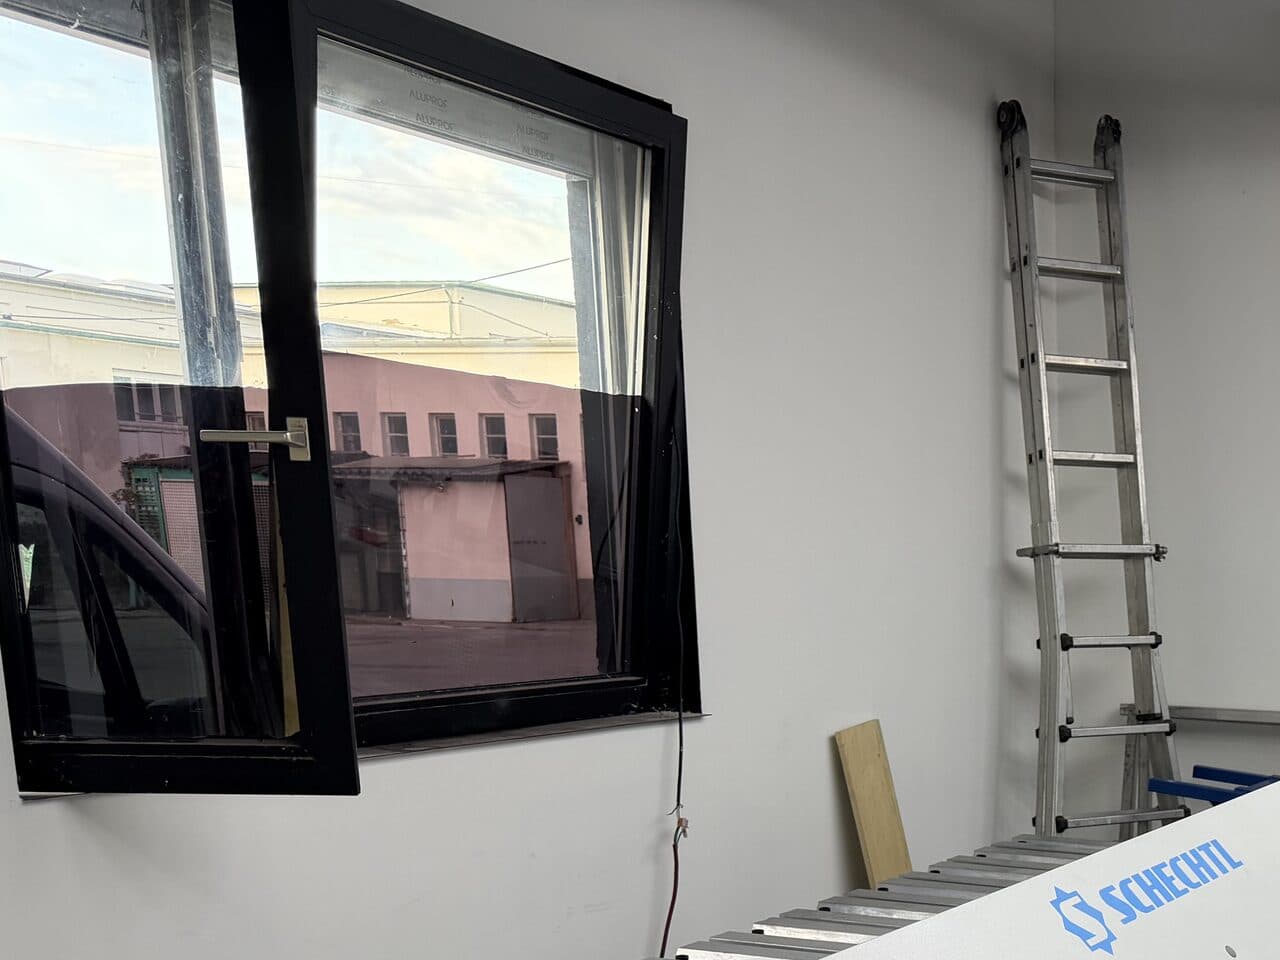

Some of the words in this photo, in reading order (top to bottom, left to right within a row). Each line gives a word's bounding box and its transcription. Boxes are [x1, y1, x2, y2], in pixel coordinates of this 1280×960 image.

[409, 88, 448, 109] ALUPROF
[415, 112, 455, 132] ALUPROF
[1098, 838, 1245, 925] SCHECHTL
